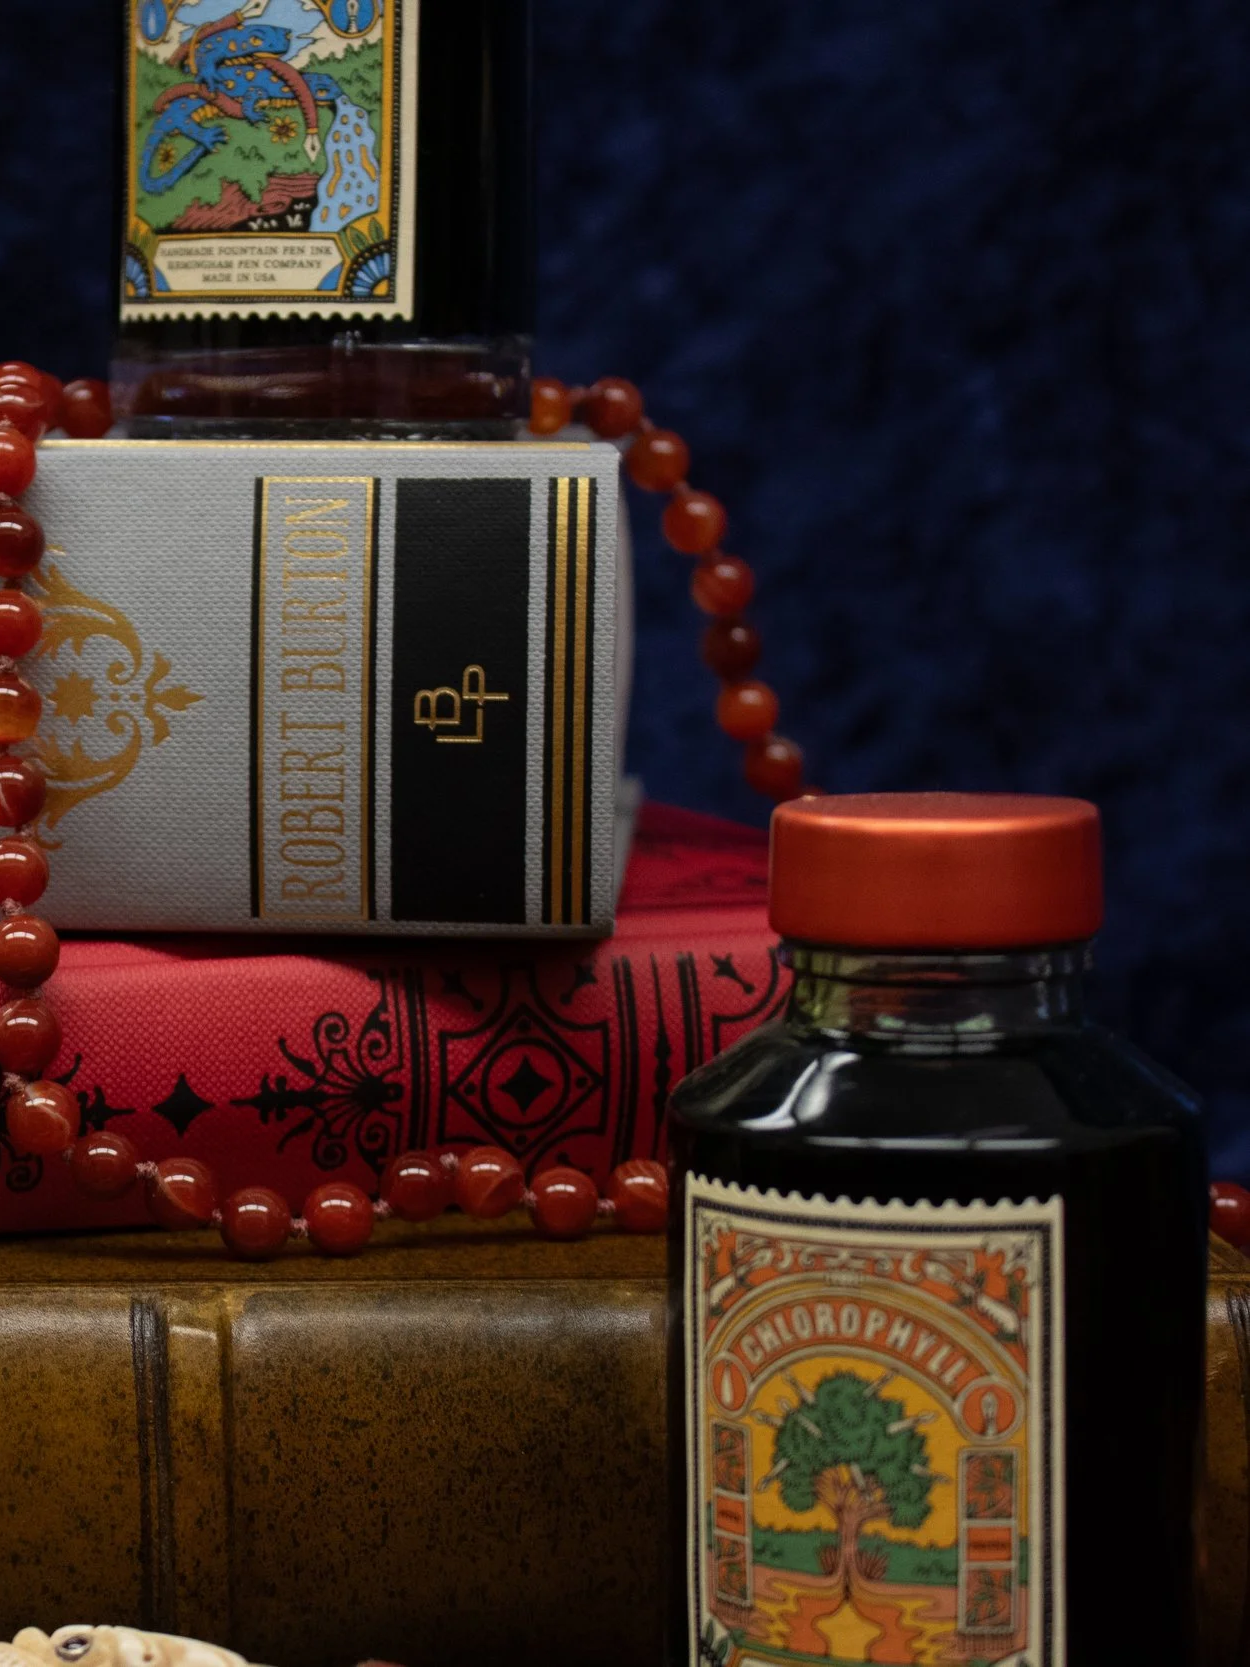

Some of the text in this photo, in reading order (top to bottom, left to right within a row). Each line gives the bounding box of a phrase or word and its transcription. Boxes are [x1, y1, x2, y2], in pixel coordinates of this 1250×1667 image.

[160, 244, 333, 258] HANDMADE FOUNTAIN PEN INK
[237, 259, 260, 270] PEN
[263, 258, 321, 270] COMPANY
[202, 273, 276, 284] MADE IN USA
[280, 496, 349, 901] ROBERT BURTON
[740, 1303, 971, 1388] CHLOROPHYLL
